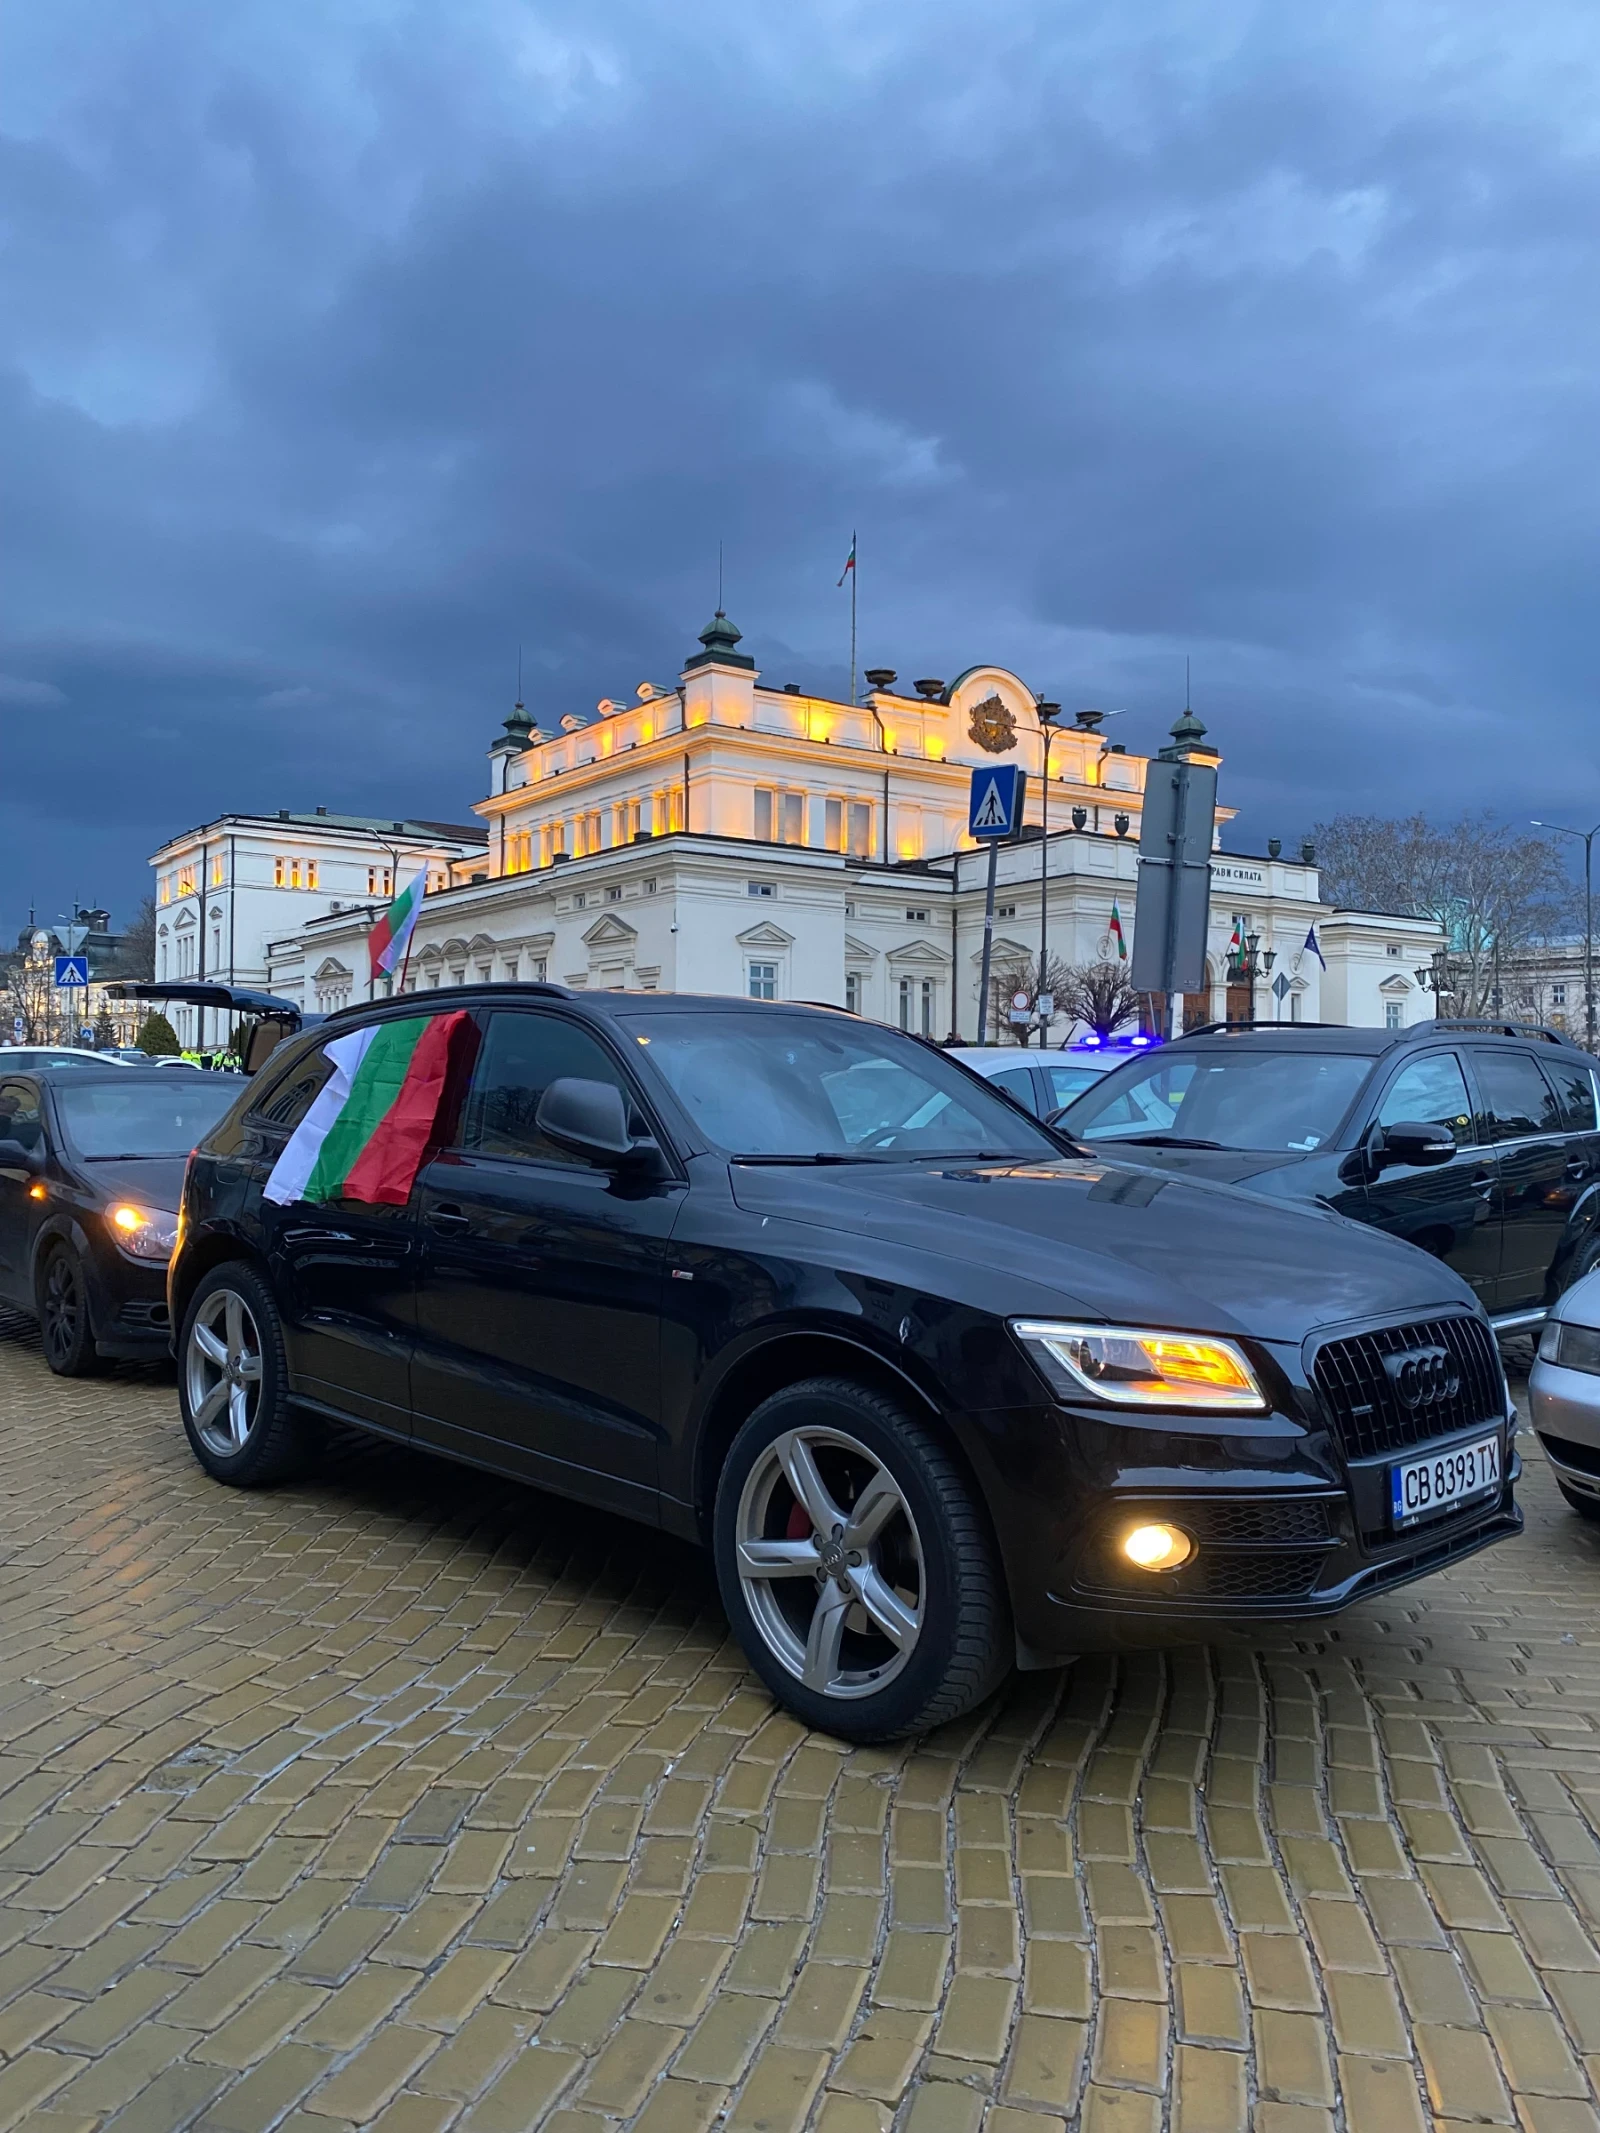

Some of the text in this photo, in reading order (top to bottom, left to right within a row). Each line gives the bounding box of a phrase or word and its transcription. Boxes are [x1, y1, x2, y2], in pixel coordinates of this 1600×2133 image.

[1234, 870, 1262, 881] СИЛАТА
[1405, 1442, 1497, 1509] CB 8393 TX
[1393, 1500, 1402, 1514] BG
